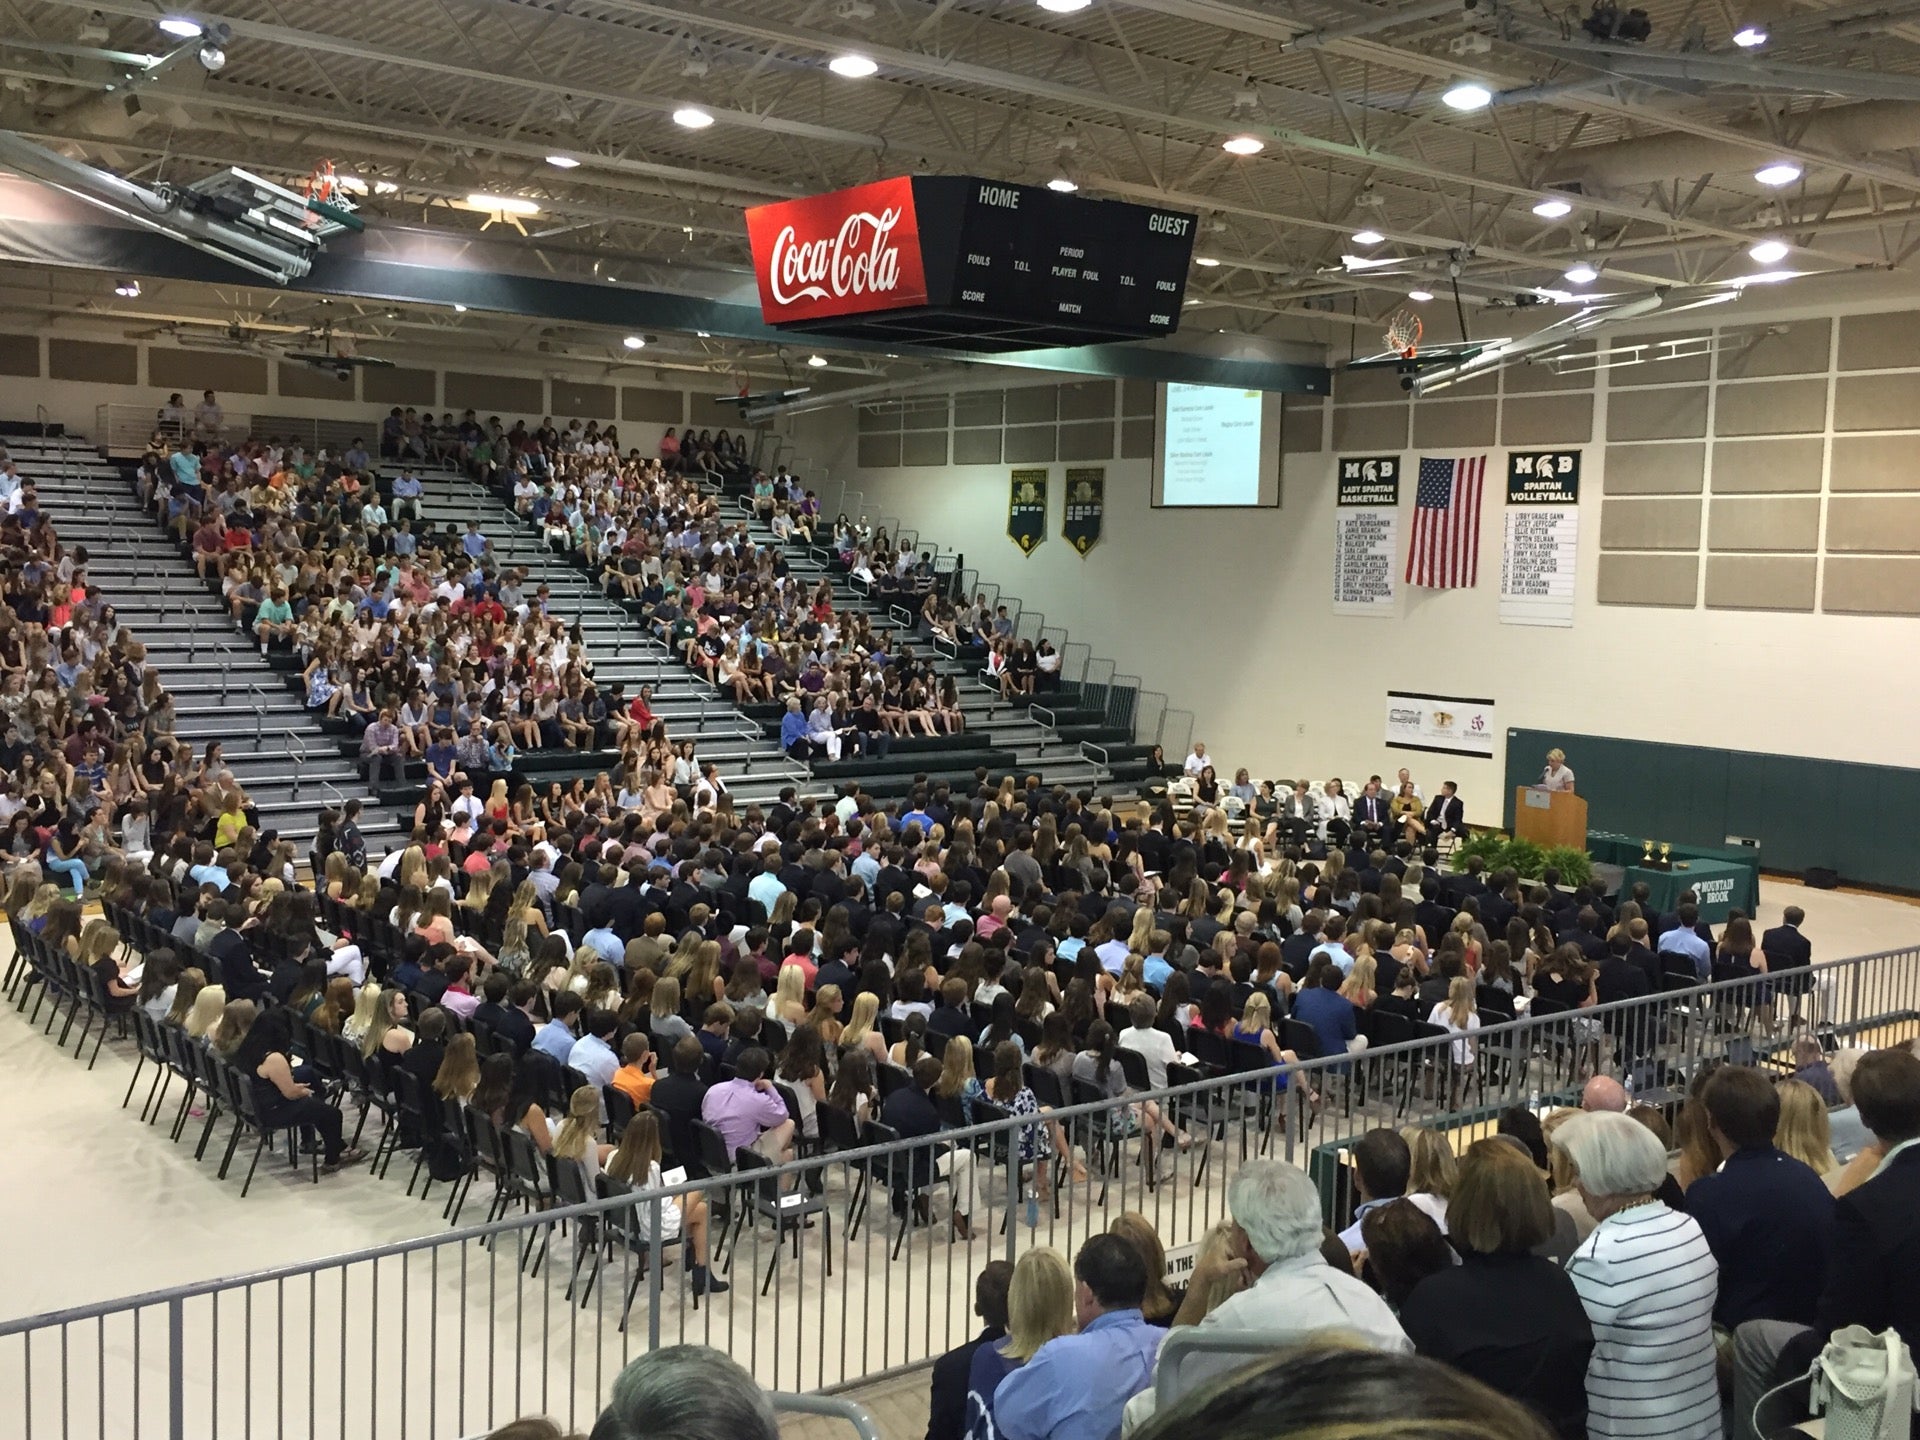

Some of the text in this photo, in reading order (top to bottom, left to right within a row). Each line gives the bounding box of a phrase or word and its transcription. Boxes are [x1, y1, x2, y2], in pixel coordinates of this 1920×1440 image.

[979, 185, 1020, 209] HOME
[1148, 213, 1190, 237] GUEST
[770, 206, 902, 305] Coca-Cola
[1059, 246, 1085, 259] PERIOD
[967, 254, 991, 267] FOULS
[1051, 266, 1099, 281] PLAYER FOUL
[1155, 280, 1176, 292] FOULS
[961, 290, 985, 302] SCORE
[1058, 302, 1082, 314] MATCH
[1149, 314, 1170, 325] SCORE
[1345, 461, 1393, 478] M B
[1515, 456, 1573, 474] M B
[1362, 485, 1394, 493] SPARTAN
[1523, 482, 1562, 490] SPARTAN
[1340, 495, 1394, 503] BASKETBALL
[1511, 492, 1574, 501] VOLLEYBALL
[1701, 878, 1734, 893] MOUNTAIN
[1707, 891, 1728, 903] BROOK
[1166, 1255, 1193, 1275] N THE
